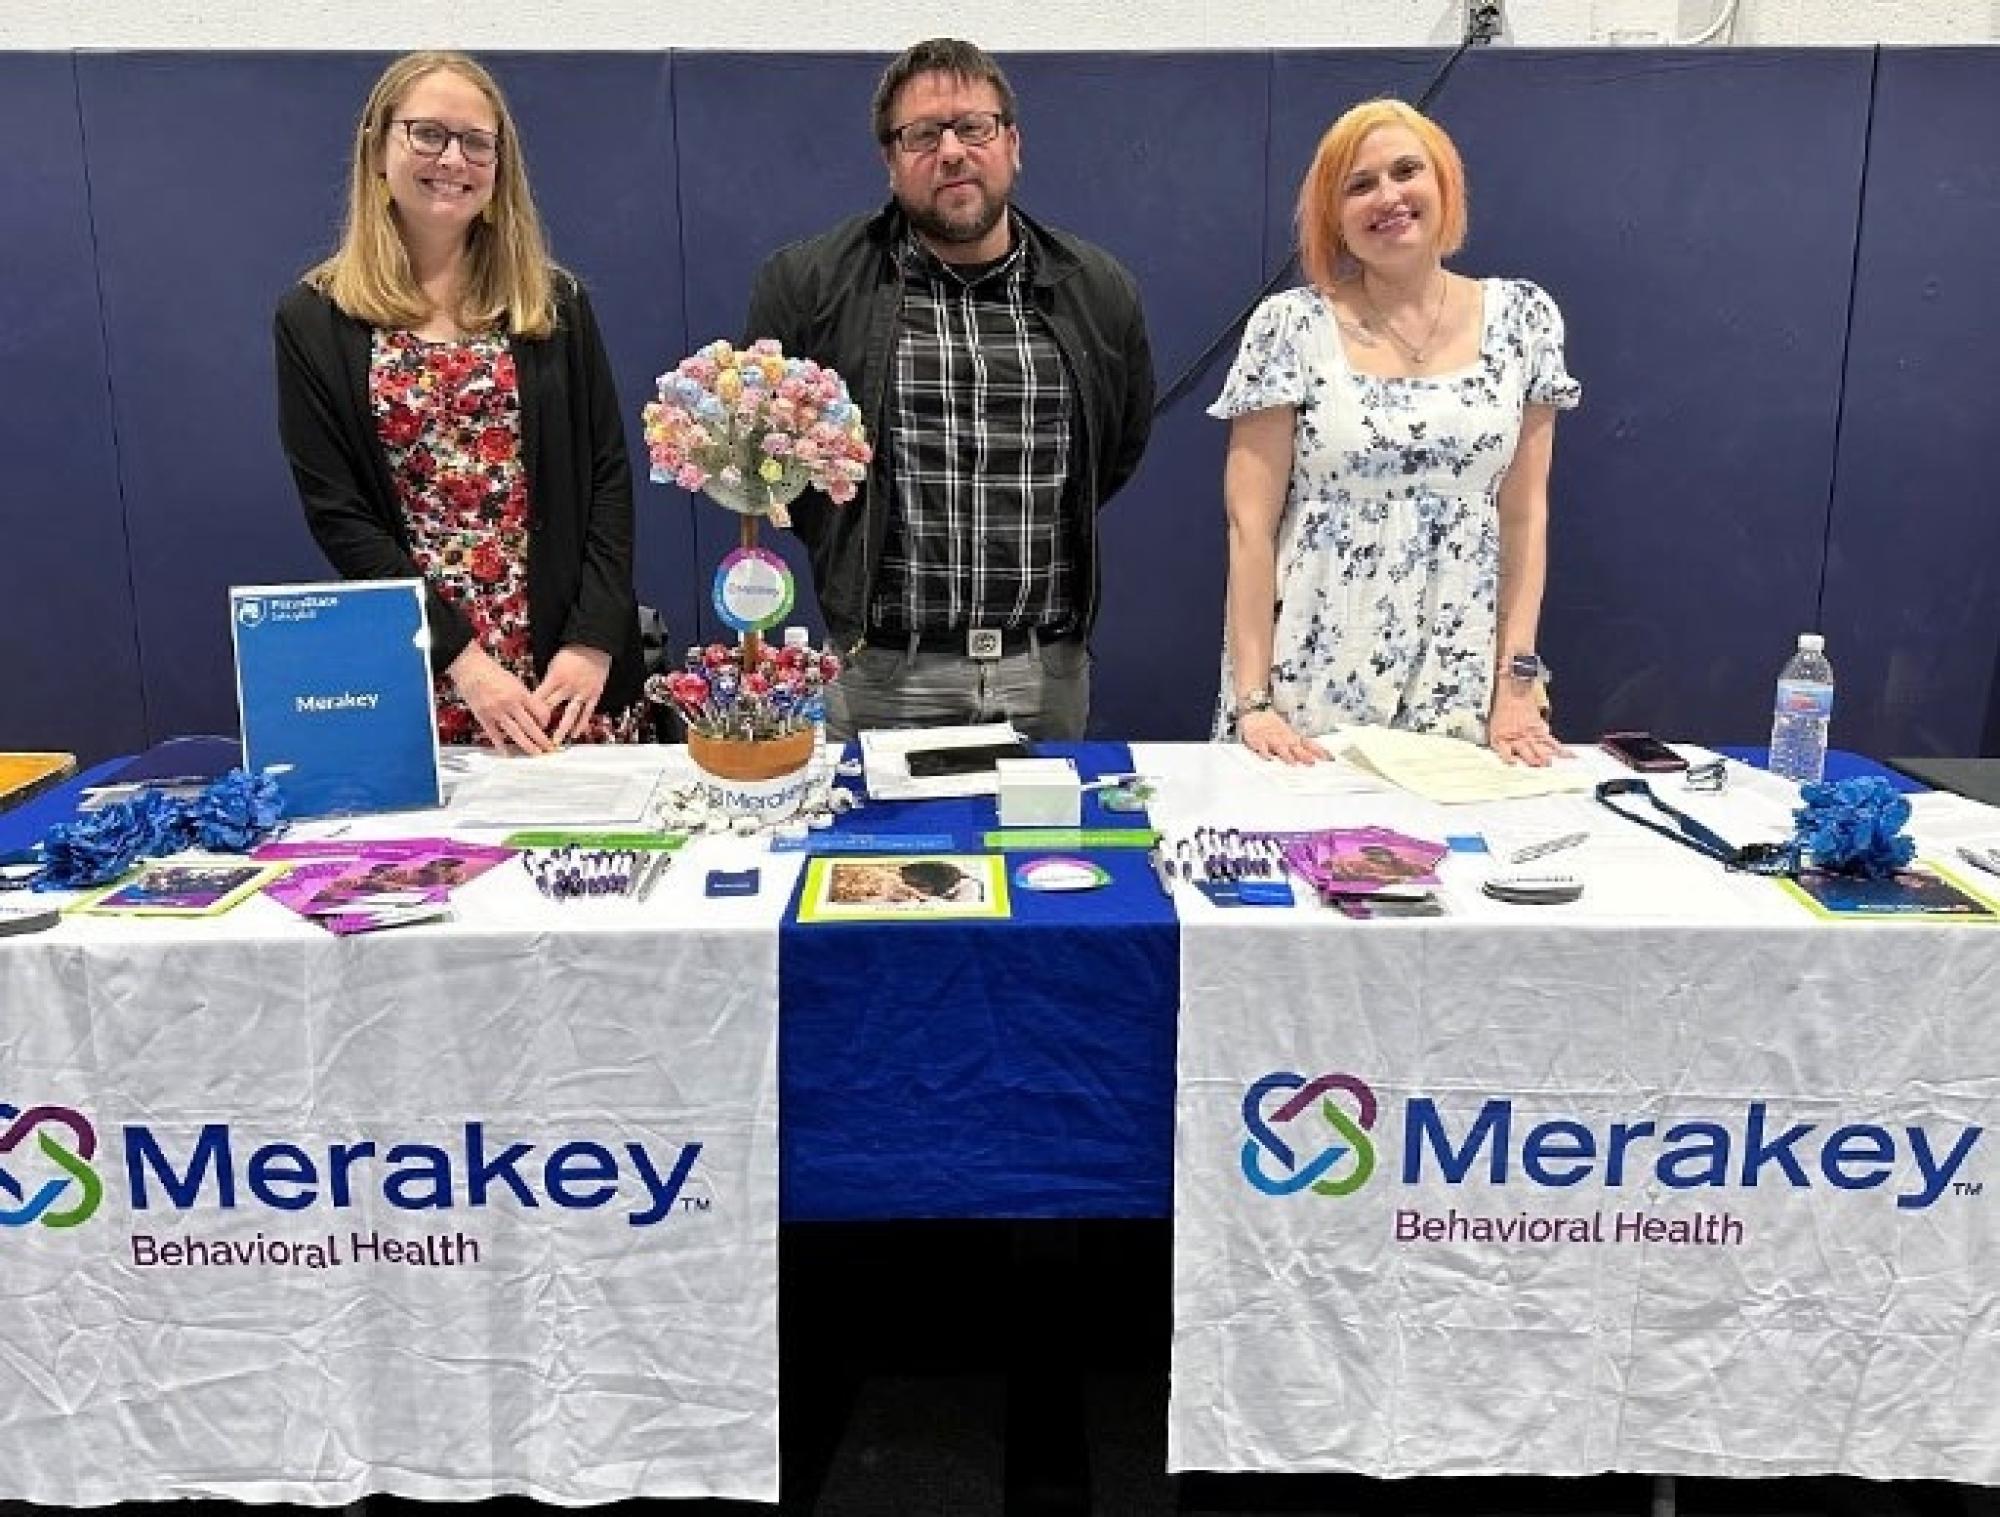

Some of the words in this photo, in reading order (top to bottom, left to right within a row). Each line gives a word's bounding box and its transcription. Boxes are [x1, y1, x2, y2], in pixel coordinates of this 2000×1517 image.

[295, 691, 379, 712] Merakey
[1402, 1097, 1984, 1208] Merakey
[123, 1121, 703, 1227] Merakey
[1395, 1208, 1605, 1243] Behavioral
[1614, 1211, 1744, 1245] Health
[131, 1232, 342, 1269] Behavioral
[351, 1231, 480, 1266] Health
